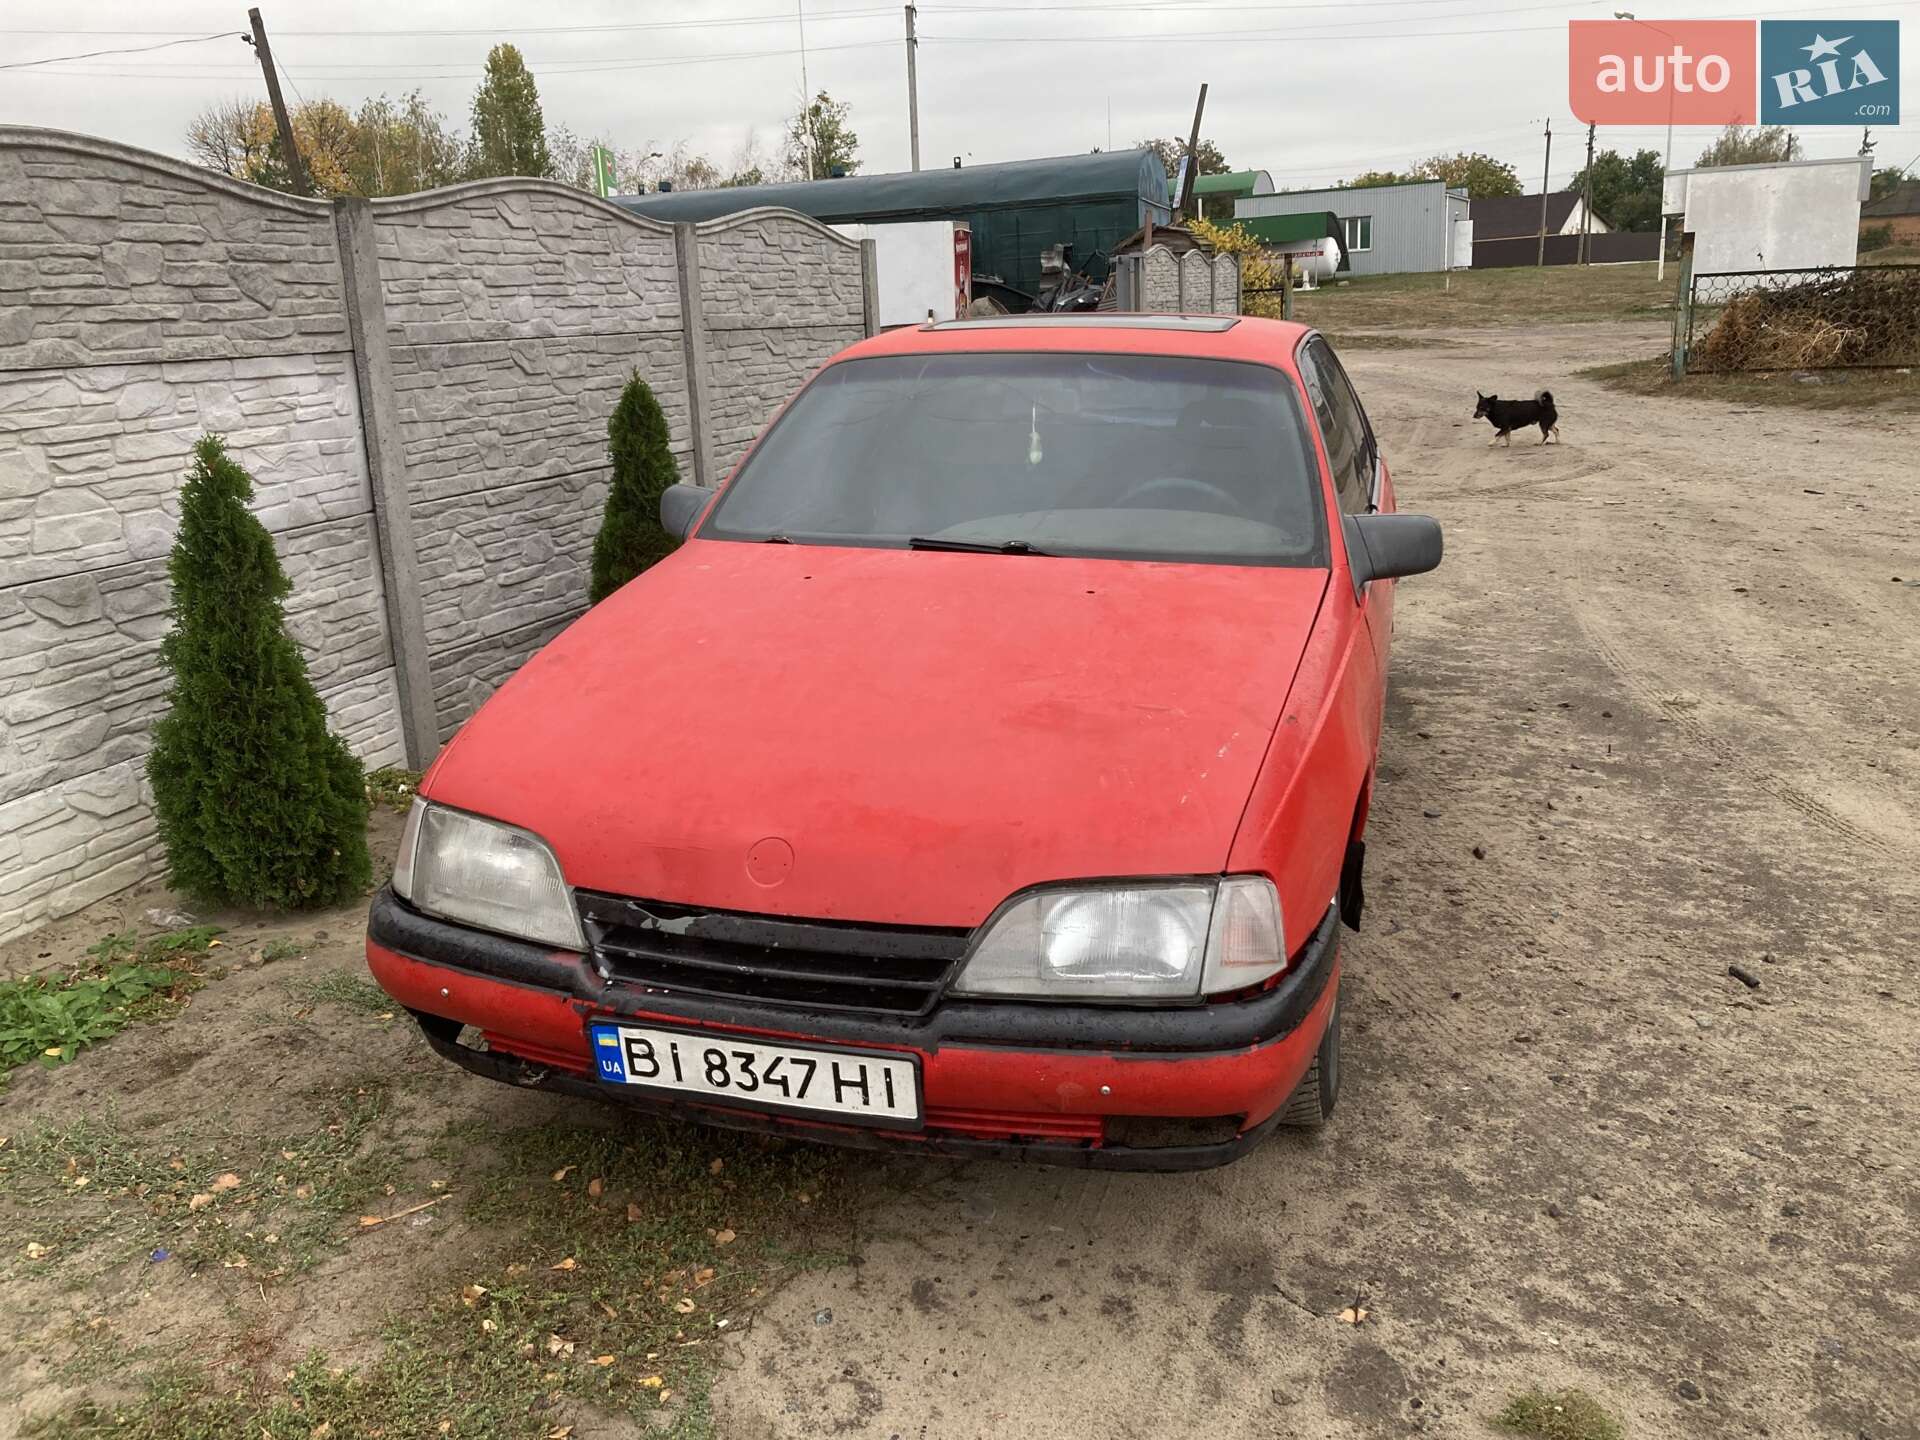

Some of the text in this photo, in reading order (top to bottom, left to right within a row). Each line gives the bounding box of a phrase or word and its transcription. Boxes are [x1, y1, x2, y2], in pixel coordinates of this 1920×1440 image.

[602, 1060, 622, 1075] UA
[703, 1048, 817, 1099] 8347
[832, 1062, 895, 1108] HI
